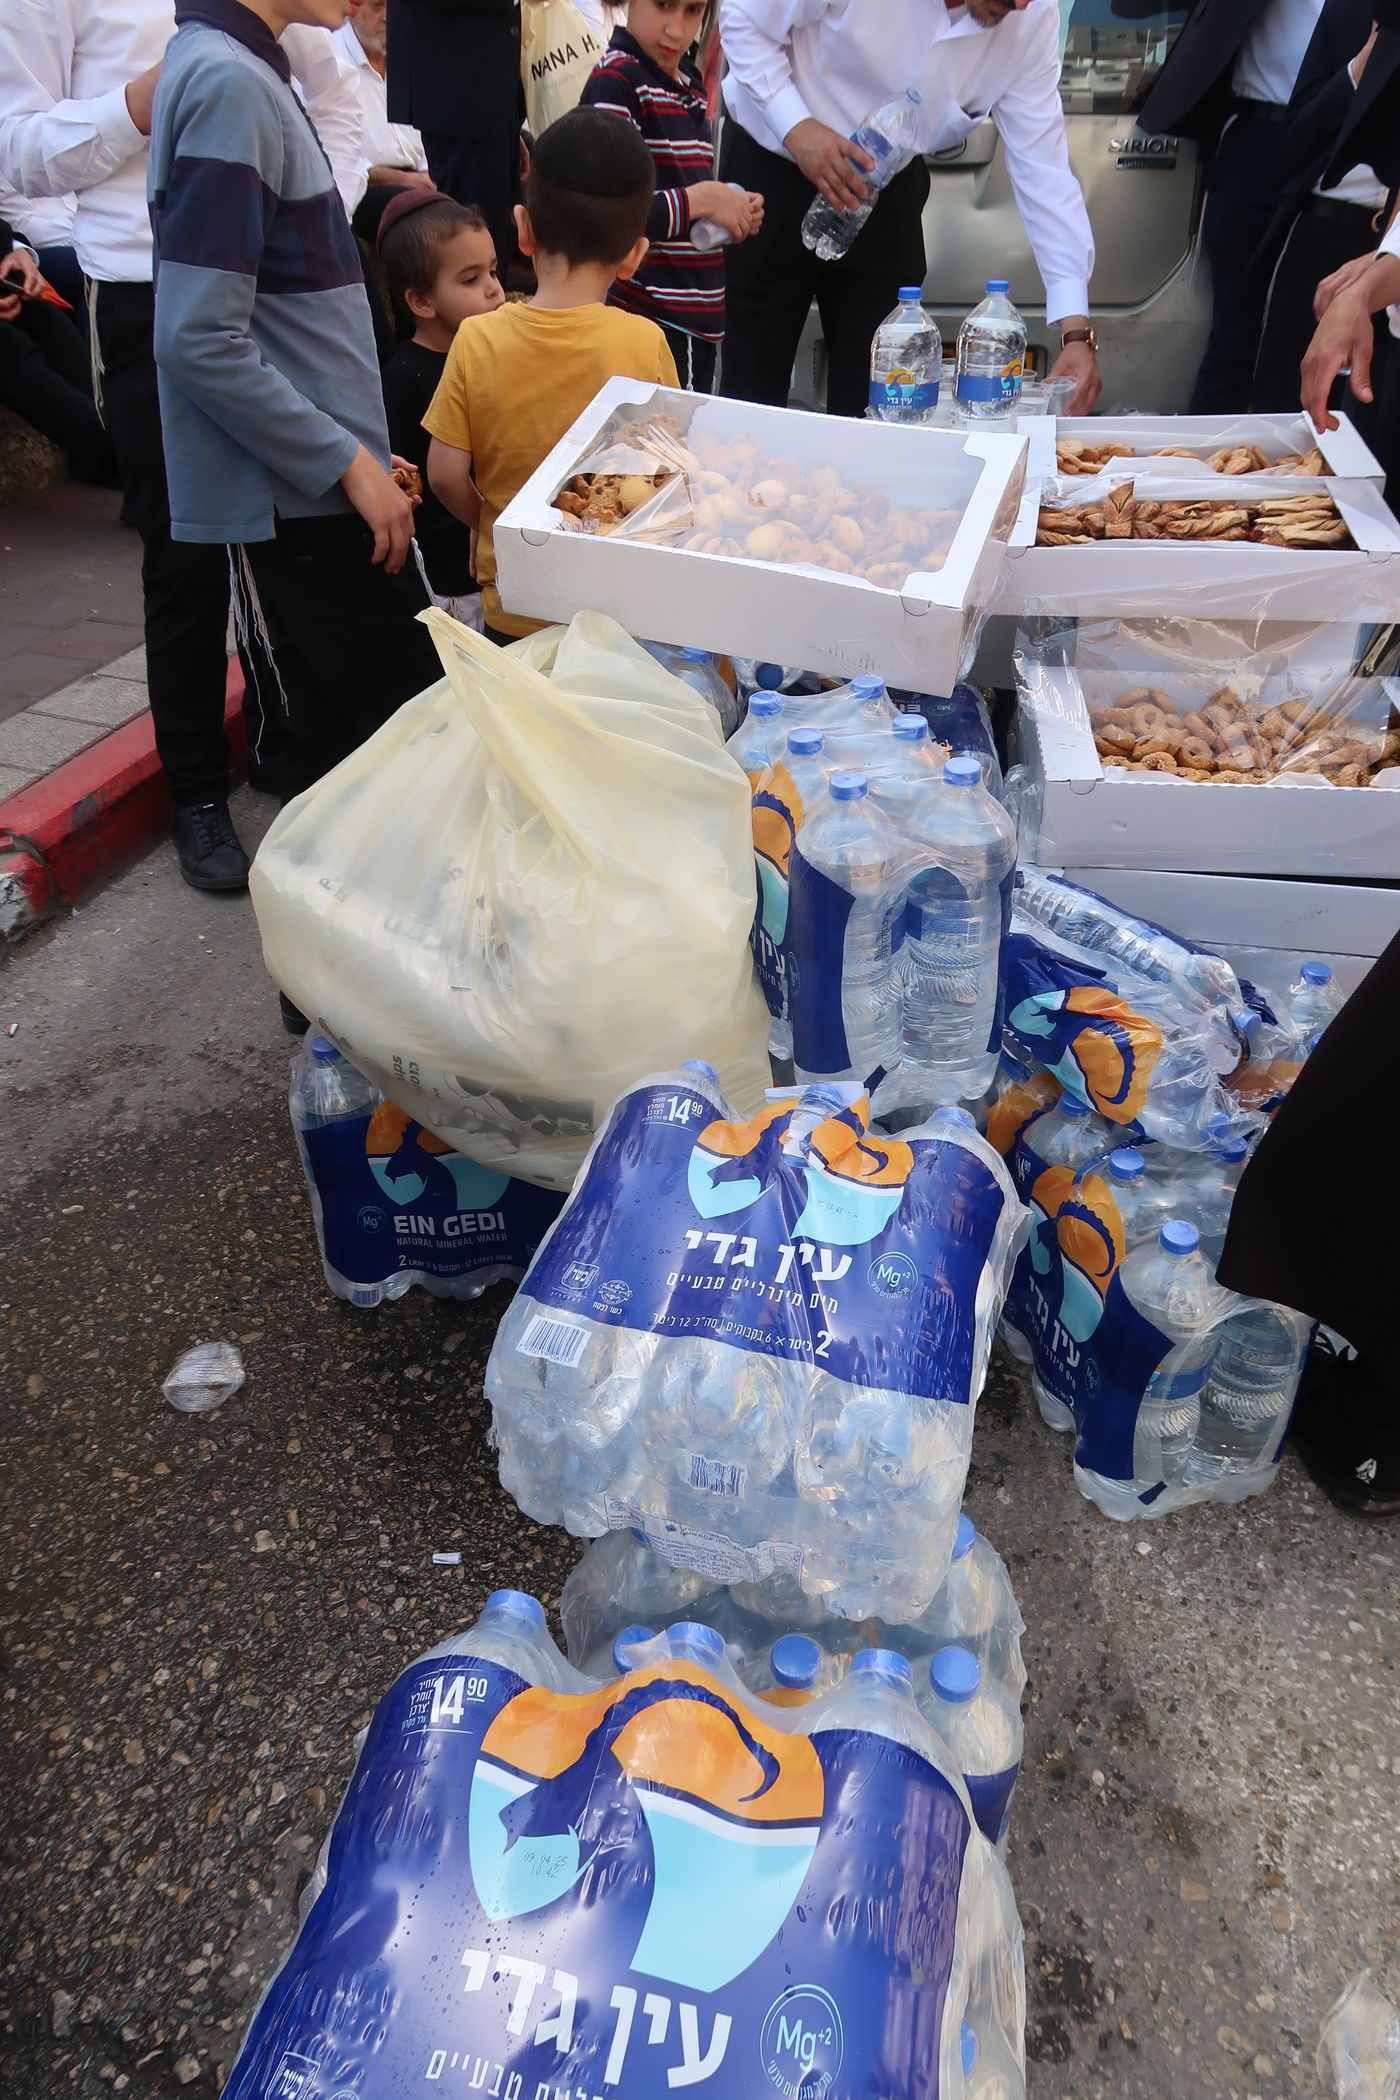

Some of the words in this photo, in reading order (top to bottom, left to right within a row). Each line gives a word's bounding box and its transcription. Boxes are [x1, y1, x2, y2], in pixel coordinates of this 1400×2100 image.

[531, 42, 579, 81] NANA
[582, 33, 600, 53] H.
[1108, 138, 1179, 152] SIRION
[760, 929, 785, 975] עין
[667, 1095, 691, 1124] 14
[691, 1101, 703, 1115] 90
[394, 1215, 436, 1236] EIN
[443, 1212, 506, 1237] GEDI
[396, 1236, 435, 1249] NATURAL
[436, 1237, 474, 1249] MINERAL
[476, 1232, 508, 1244] WATER
[684, 1229, 758, 1268] גדי
[398, 1254, 408, 1267] 2
[570, 1267, 589, 1283] כשר
[774, 1243, 853, 1284] עין
[666, 1271, 726, 1290] טבעיים
[731, 1278, 802, 1307] מינרליים
[809, 1293, 839, 1314] מים
[1028, 1274, 1050, 1332] גדי
[679, 1317, 691, 1327] 12
[725, 1321, 764, 1341] בקבוקים
[764, 1332, 772, 1343] 6
[815, 1330, 833, 1359] 2
[1051, 1319, 1081, 1368] עין
[430, 1675, 466, 1725] 14
[466, 1677, 488, 1698] 90
[460, 1949, 579, 2054] גדי
[603, 1985, 733, 2089] עין
[425, 2049, 523, 2100] טבעיים
